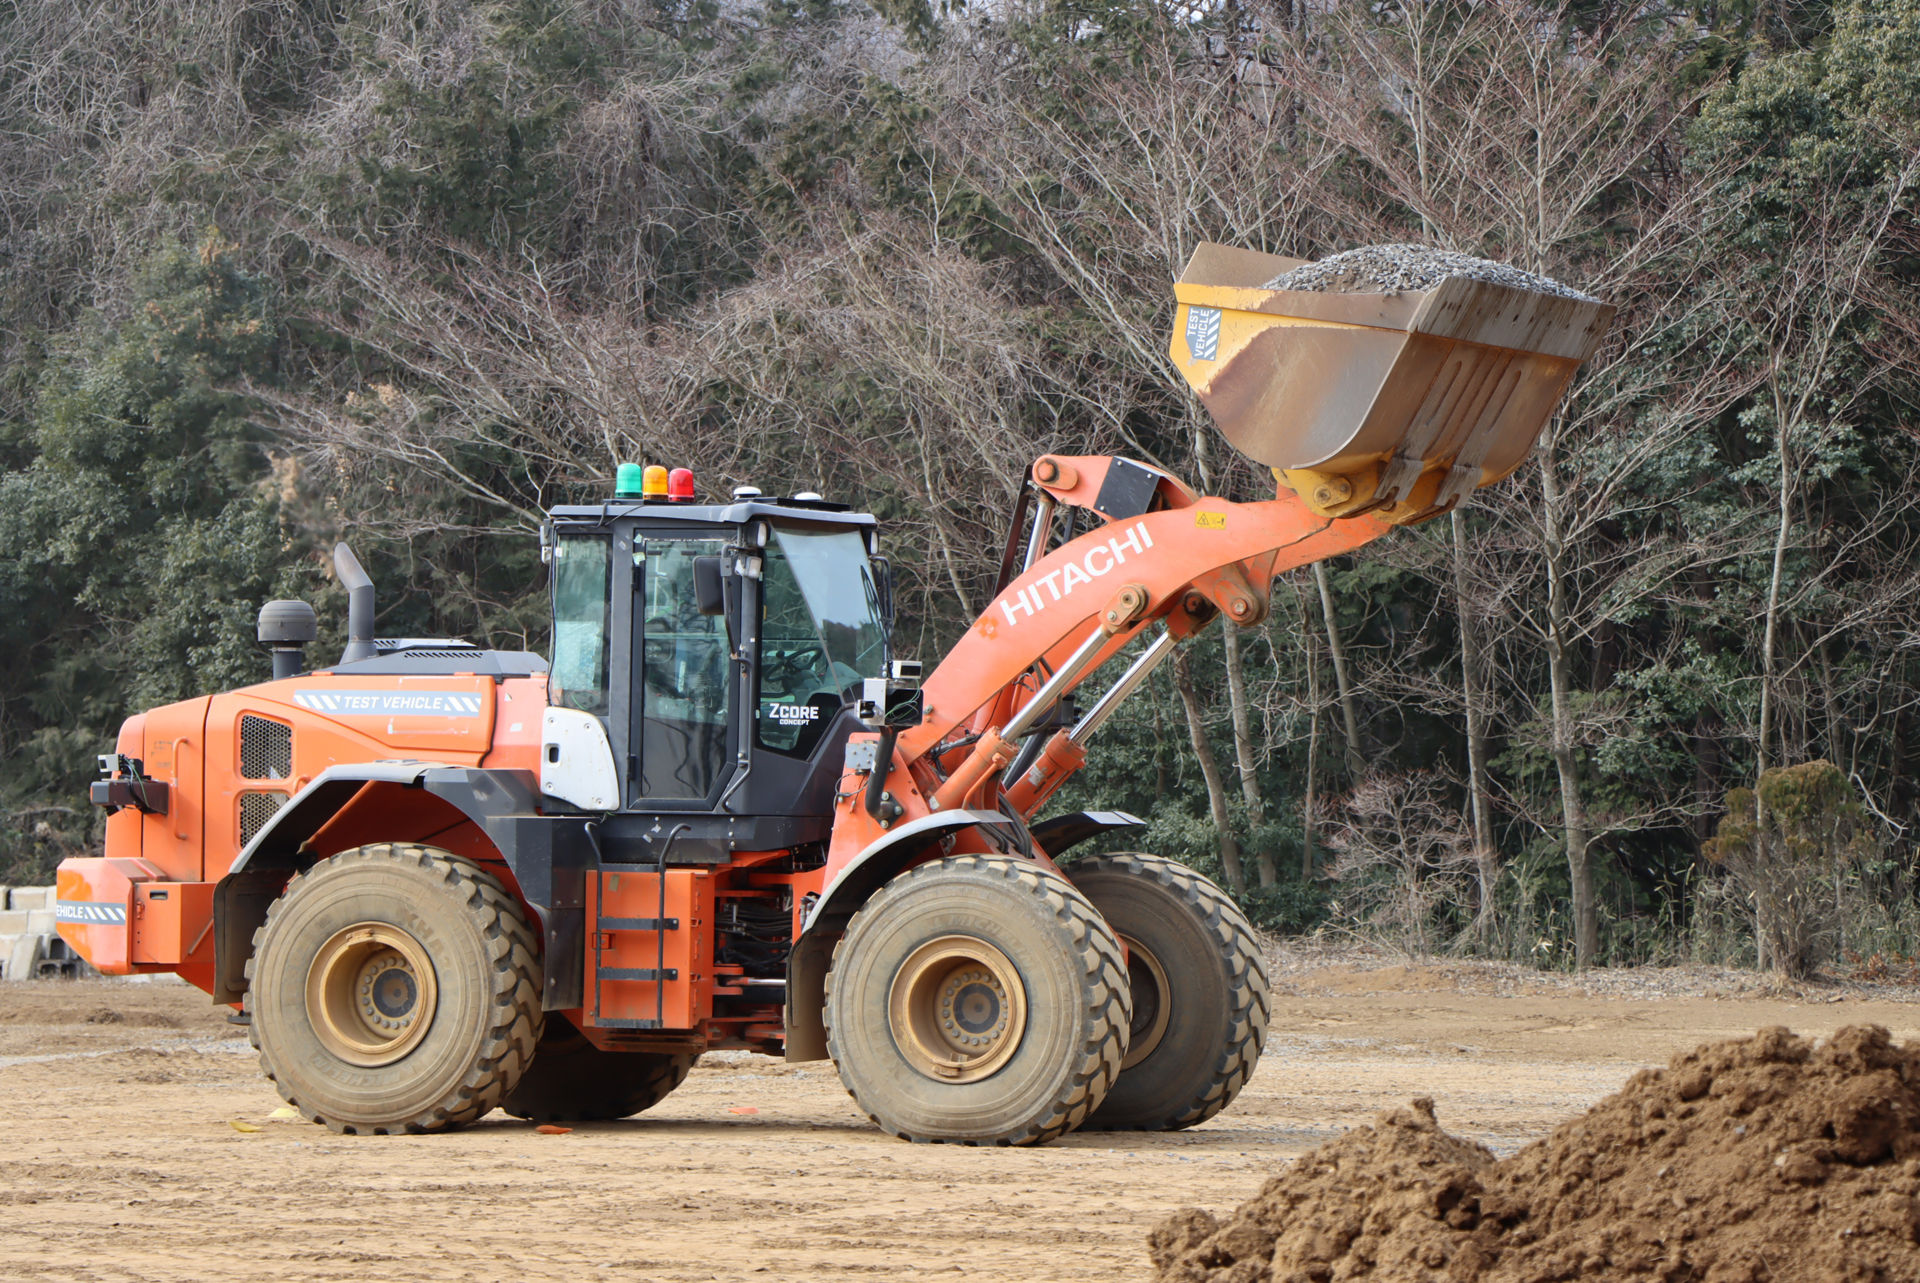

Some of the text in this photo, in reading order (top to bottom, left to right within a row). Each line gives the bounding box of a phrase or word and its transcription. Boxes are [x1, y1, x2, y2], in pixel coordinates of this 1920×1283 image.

[1187, 307, 1200, 337] TEST
[1194, 309, 1210, 357] VEHICLE
[999, 521, 1155, 627] HITACHI
[343, 696, 443, 710] TEST VEHICLE
